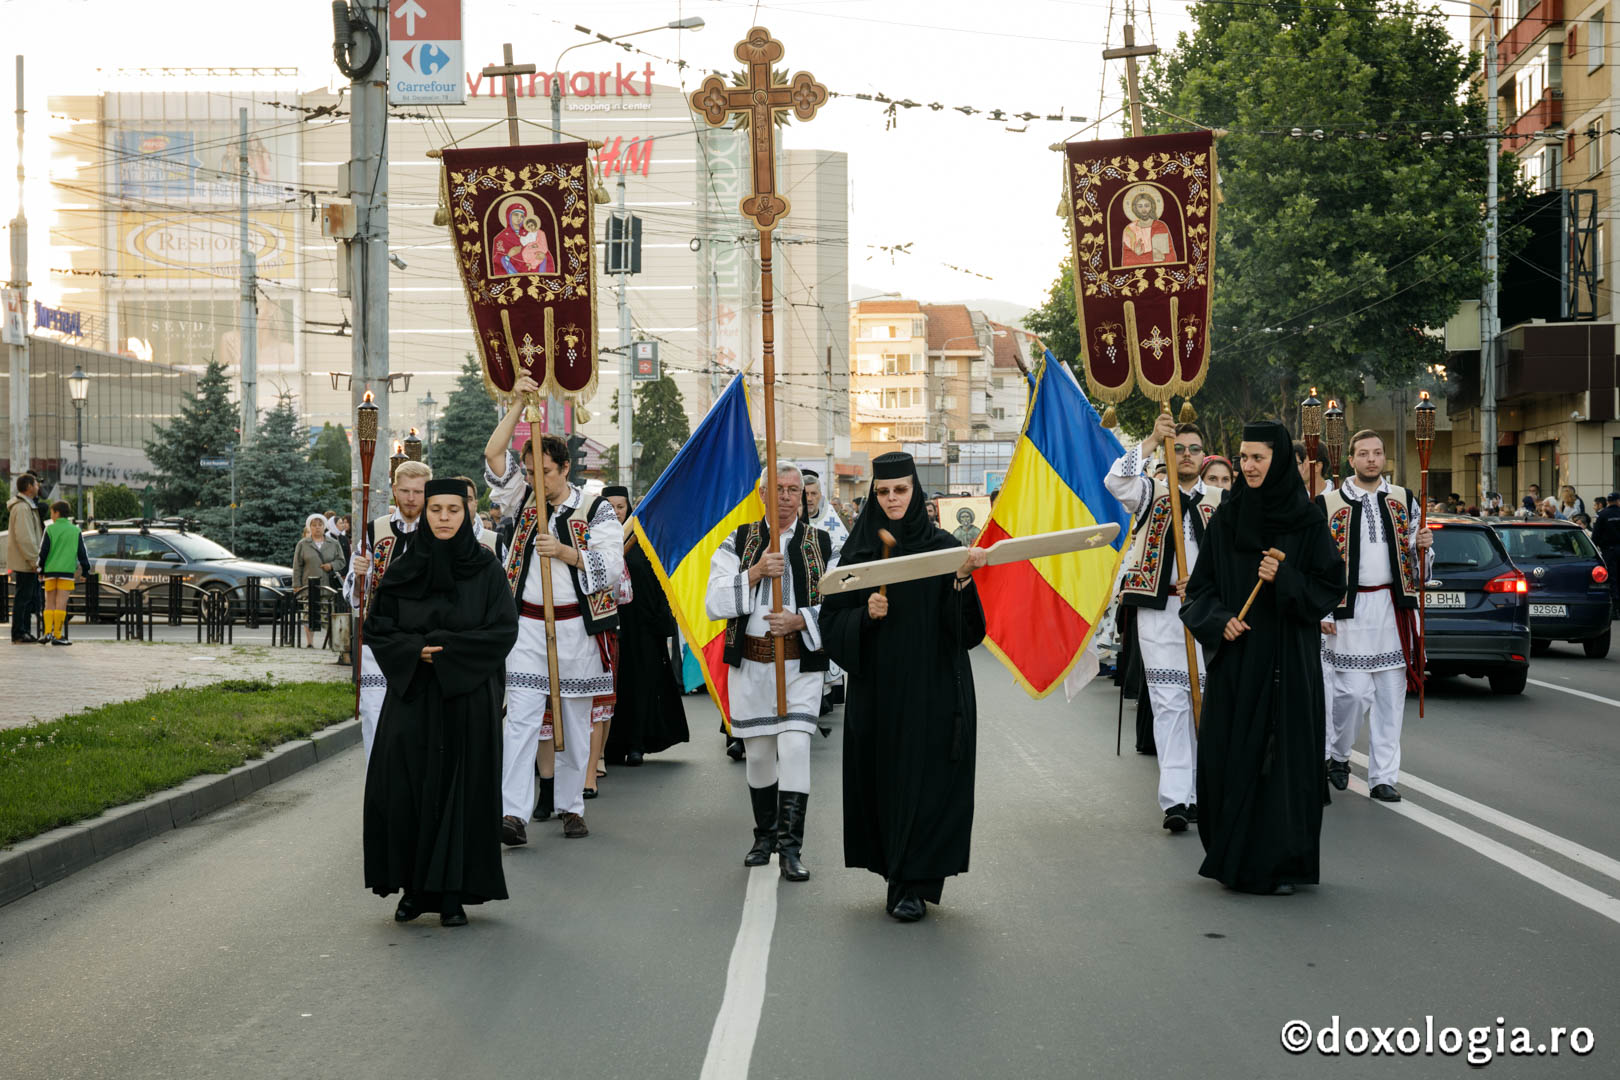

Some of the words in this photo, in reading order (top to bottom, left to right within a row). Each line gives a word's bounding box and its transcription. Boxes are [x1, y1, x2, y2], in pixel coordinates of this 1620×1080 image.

[397, 81, 456, 92] Carrefour
[568, 100, 611, 112] shopping
[623, 102, 652, 110] center
[151, 320, 216, 332] SEVDA
[1437, 593, 1461, 604] BHA
[1533, 604, 1565, 614] 92SGA
